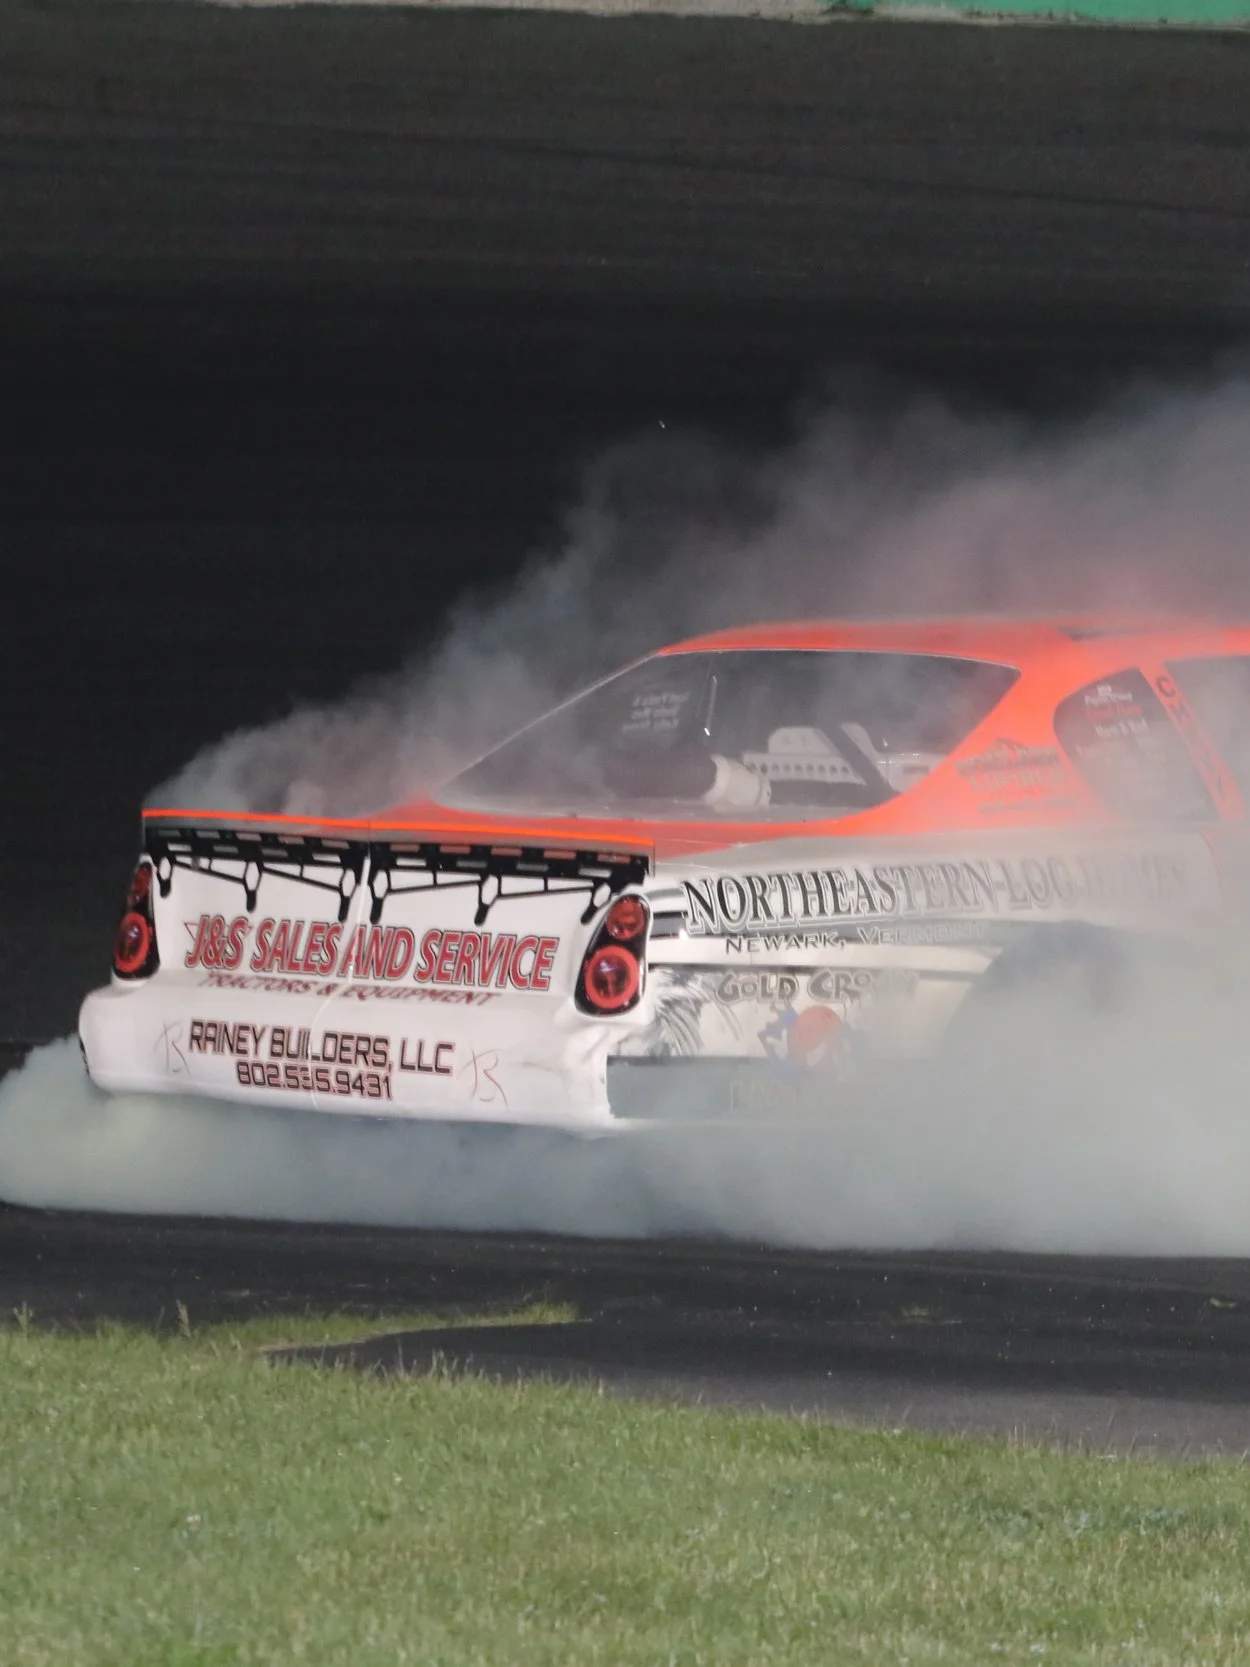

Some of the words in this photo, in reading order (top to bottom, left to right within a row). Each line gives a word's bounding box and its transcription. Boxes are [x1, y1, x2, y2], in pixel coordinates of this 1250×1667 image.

[184, 914, 250, 969] J&S
[248, 917, 345, 976] SALES
[337, 923, 417, 982] AND
[413, 928, 561, 991] SERVICE
[725, 931, 847, 955] NEWARK,
[197, 971, 315, 994] TRACTORS
[343, 983, 498, 1007] EQUIPMENT
[715, 972, 799, 1004] GOLD
[188, 1018, 268, 1056] RAINEY
[270, 1026, 394, 1073] BUILDERS,
[399, 1037, 456, 1074] LLC
